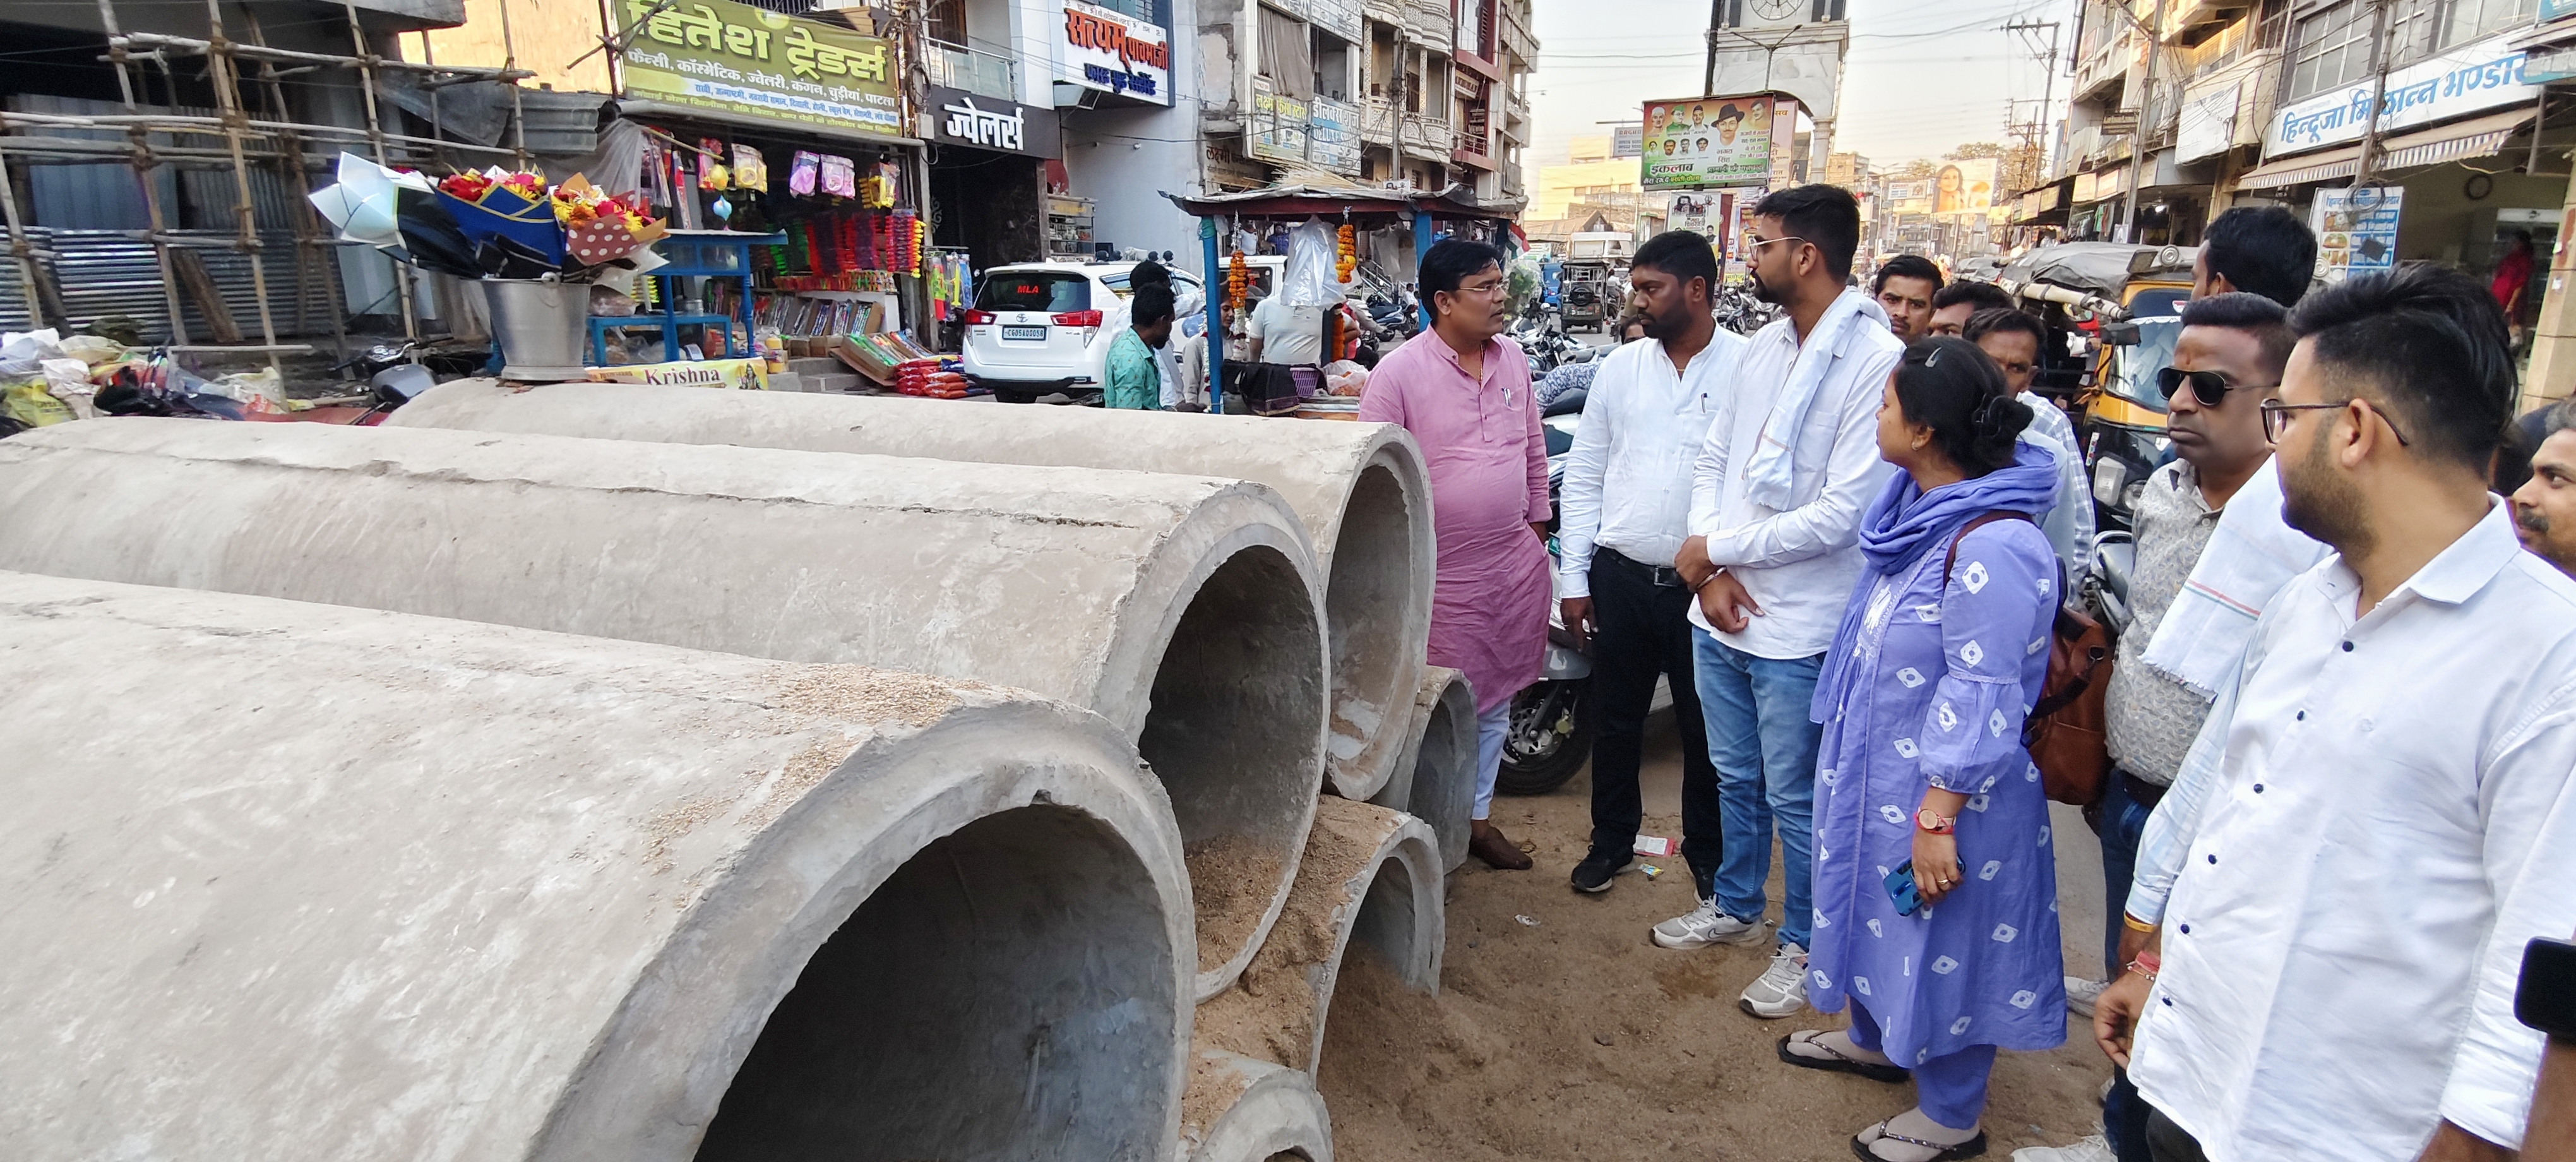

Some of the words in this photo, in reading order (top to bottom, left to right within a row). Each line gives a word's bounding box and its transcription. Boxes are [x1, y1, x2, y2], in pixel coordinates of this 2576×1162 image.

[626, 0, 770, 59] हितेश
[785, 27, 886, 81] ट्रेडर्स
[1126, 36, 1169, 71] पावभाजी
[864, 92, 895, 107] पाटला
[1312, 96, 1343, 124] डीलक्स
[2281, 104, 2347, 143] हिन्दूजा
[2349, 77, 2440, 124] मिठान्न
[944, 97, 1024, 150] ज्वेलर्स
[1340, 131, 1360, 149] SHOES
[1651, 162, 1695, 175] इंकलाब
[1017, 285, 1039, 294] MLA
[643, 367, 720, 386] Krishna
